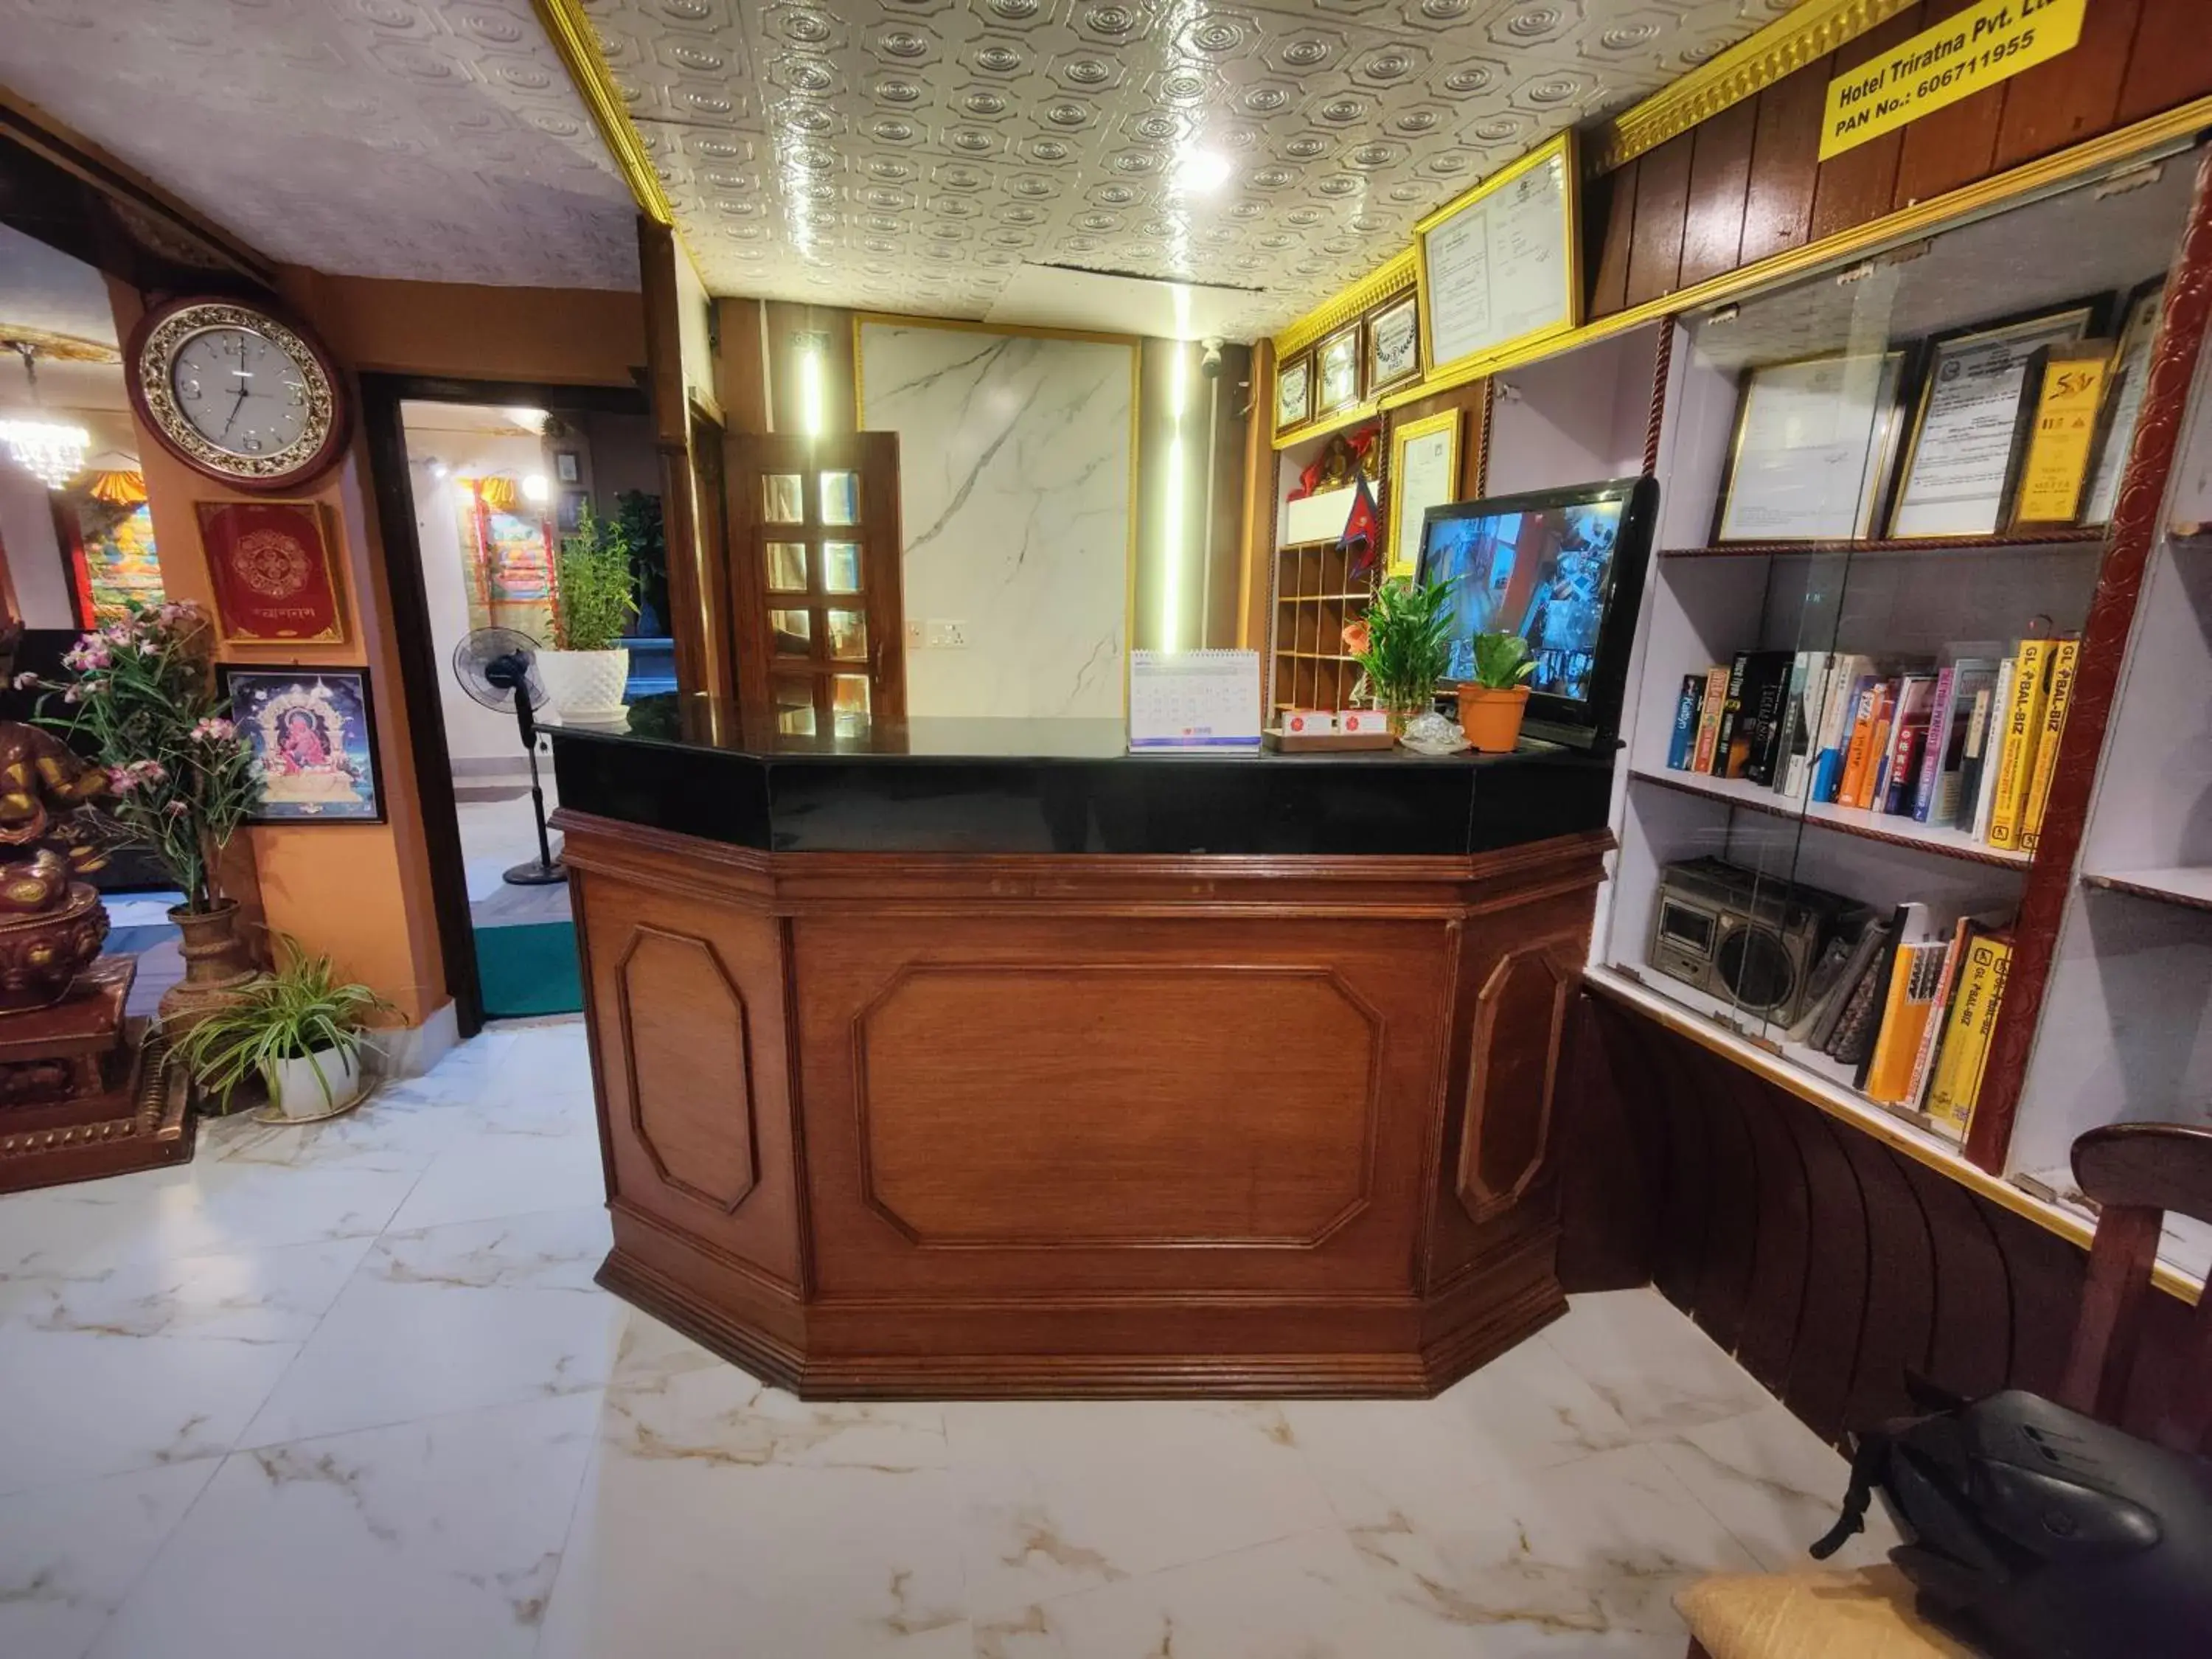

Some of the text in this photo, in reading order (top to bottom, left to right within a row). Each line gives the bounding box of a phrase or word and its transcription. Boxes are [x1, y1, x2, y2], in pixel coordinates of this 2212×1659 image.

[1835, 29, 2035, 136] PAN No.: 606711955
[1840, 70, 1883, 108] Hotel
[1891, 33, 1965, 83] Triratna
[1972, 7, 2012, 42] Pvt.
